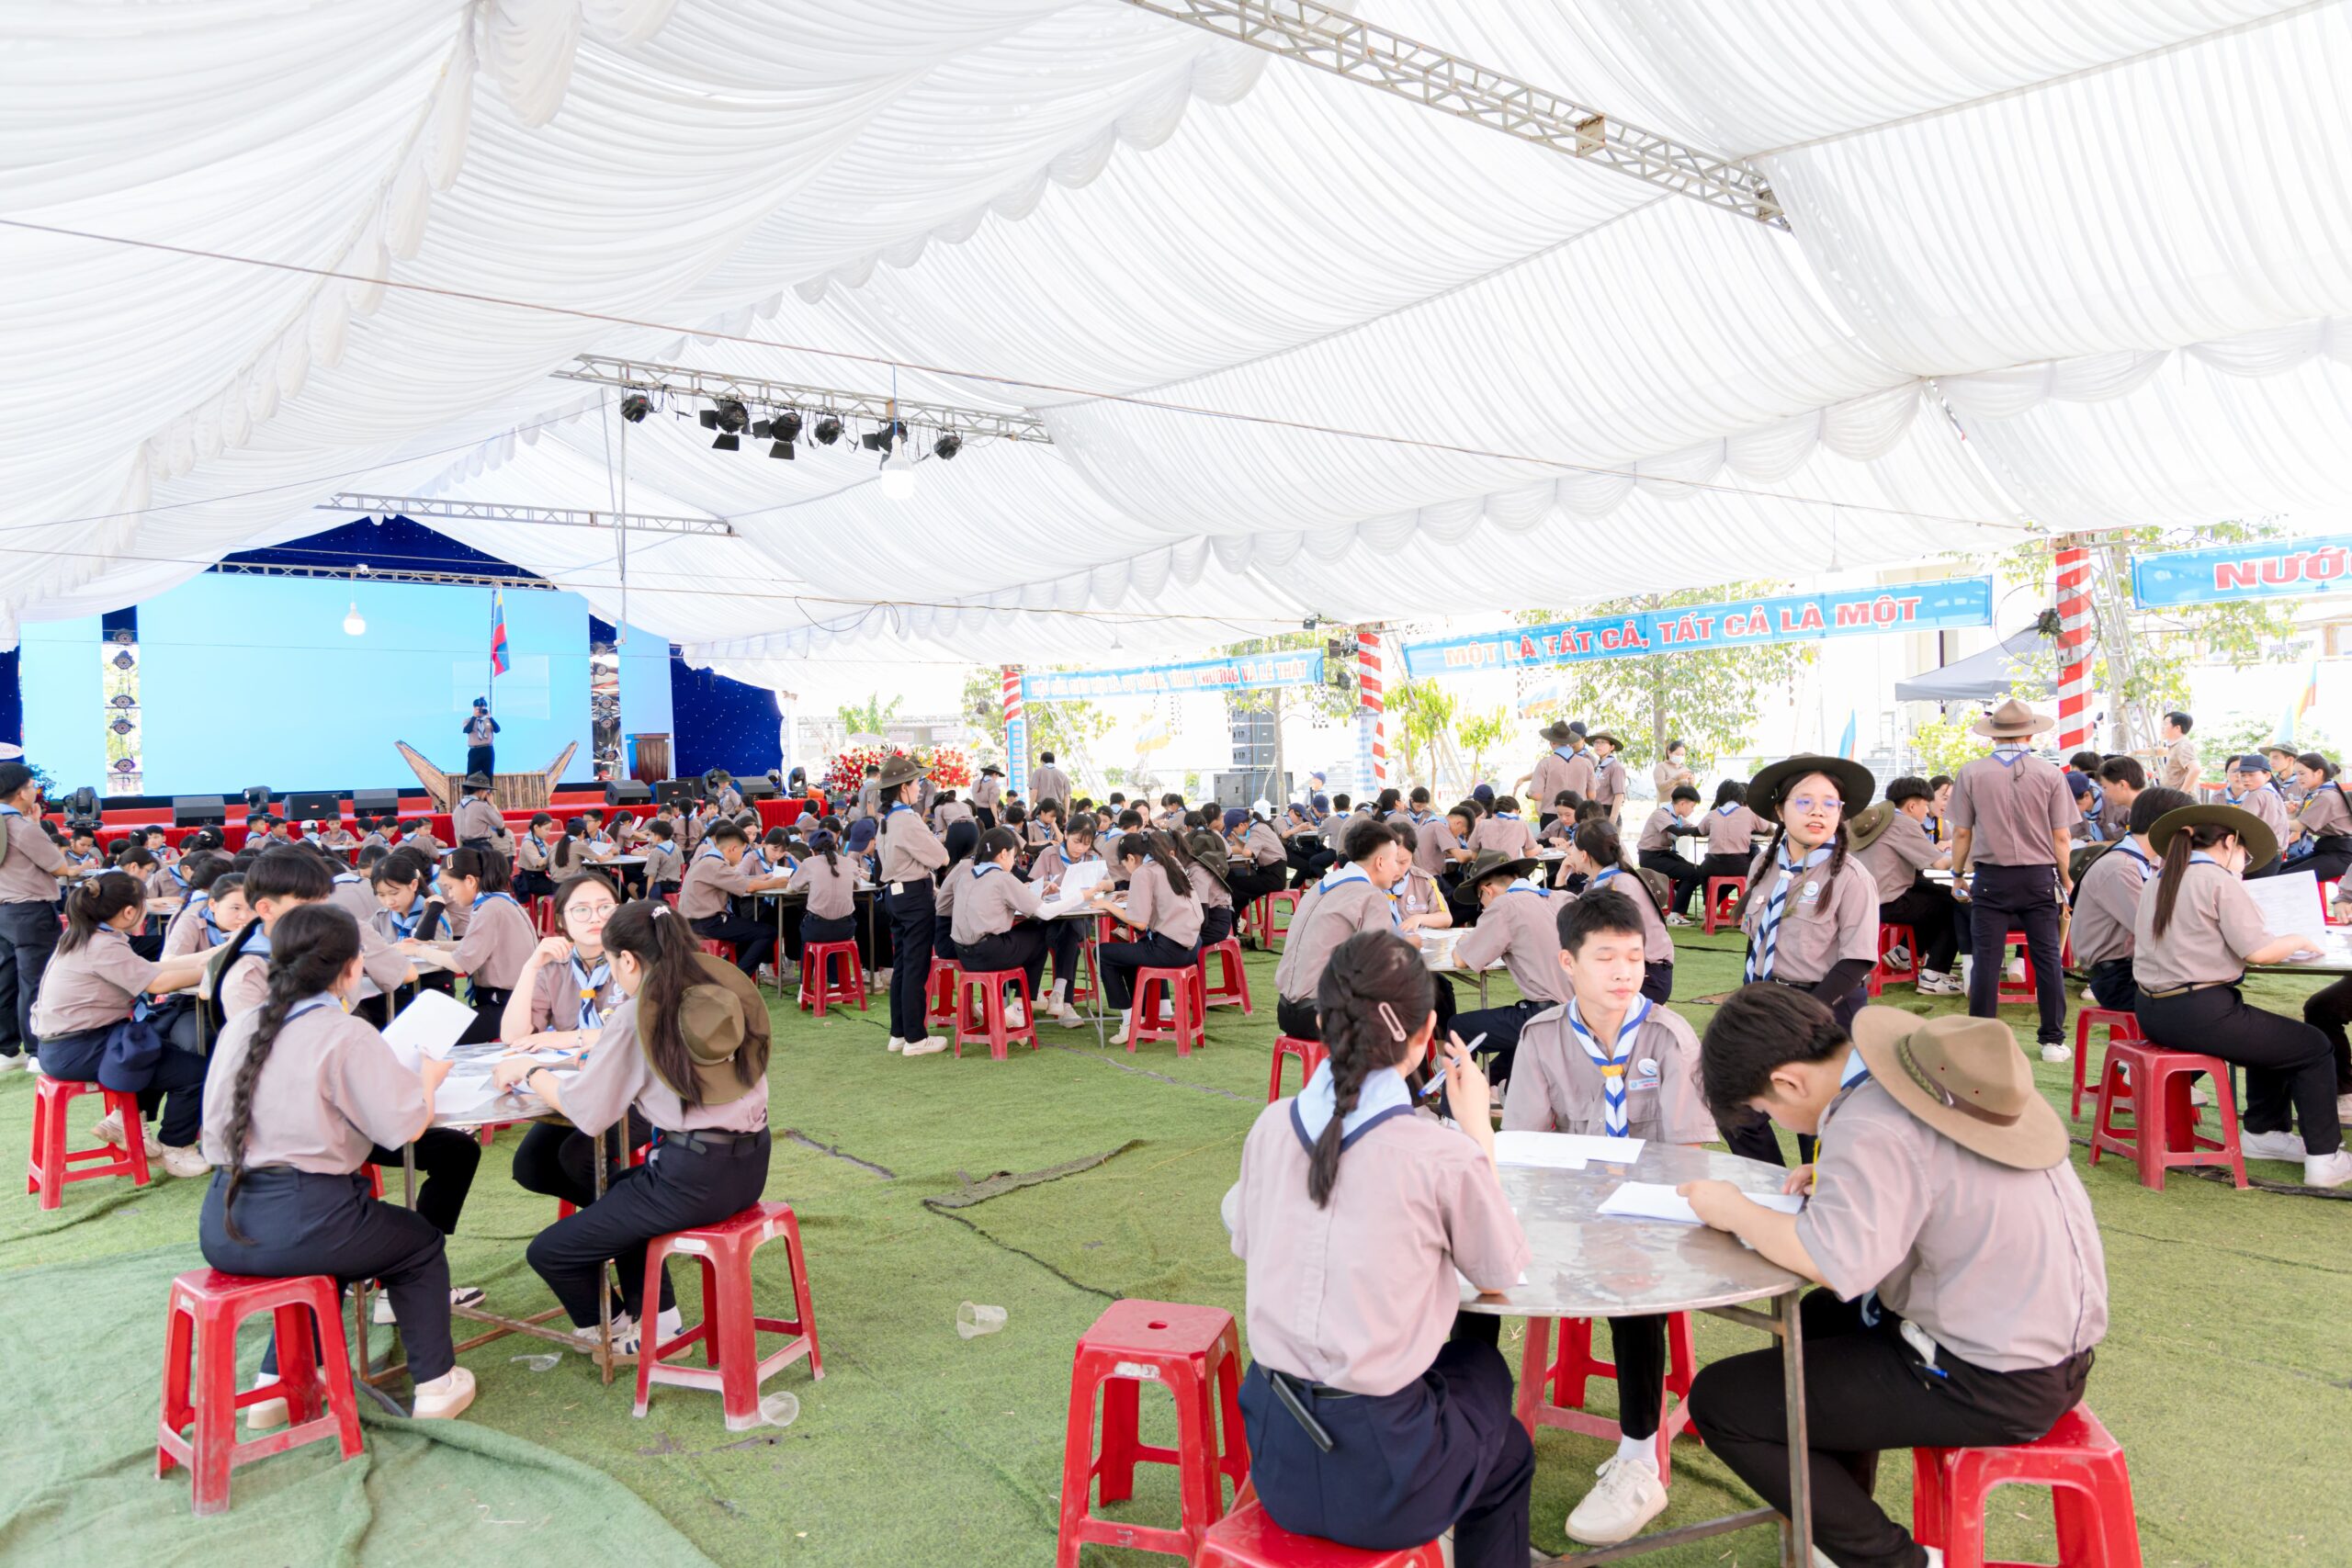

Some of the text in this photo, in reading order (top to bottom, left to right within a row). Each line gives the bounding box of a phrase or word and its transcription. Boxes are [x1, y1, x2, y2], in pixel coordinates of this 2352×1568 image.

[2215, 547, 2352, 589] NƯỚ
[1444, 594, 1921, 667] MỘT LÀ TẤT CẢ, TẤT CẢ LÀ MỘT
[1169, 668, 1193, 687] TÌNH
[1194, 665, 1240, 685] THƯƠNG
[1241, 660, 1258, 682] VÀ
[1275, 658, 1308, 682] THẬT
